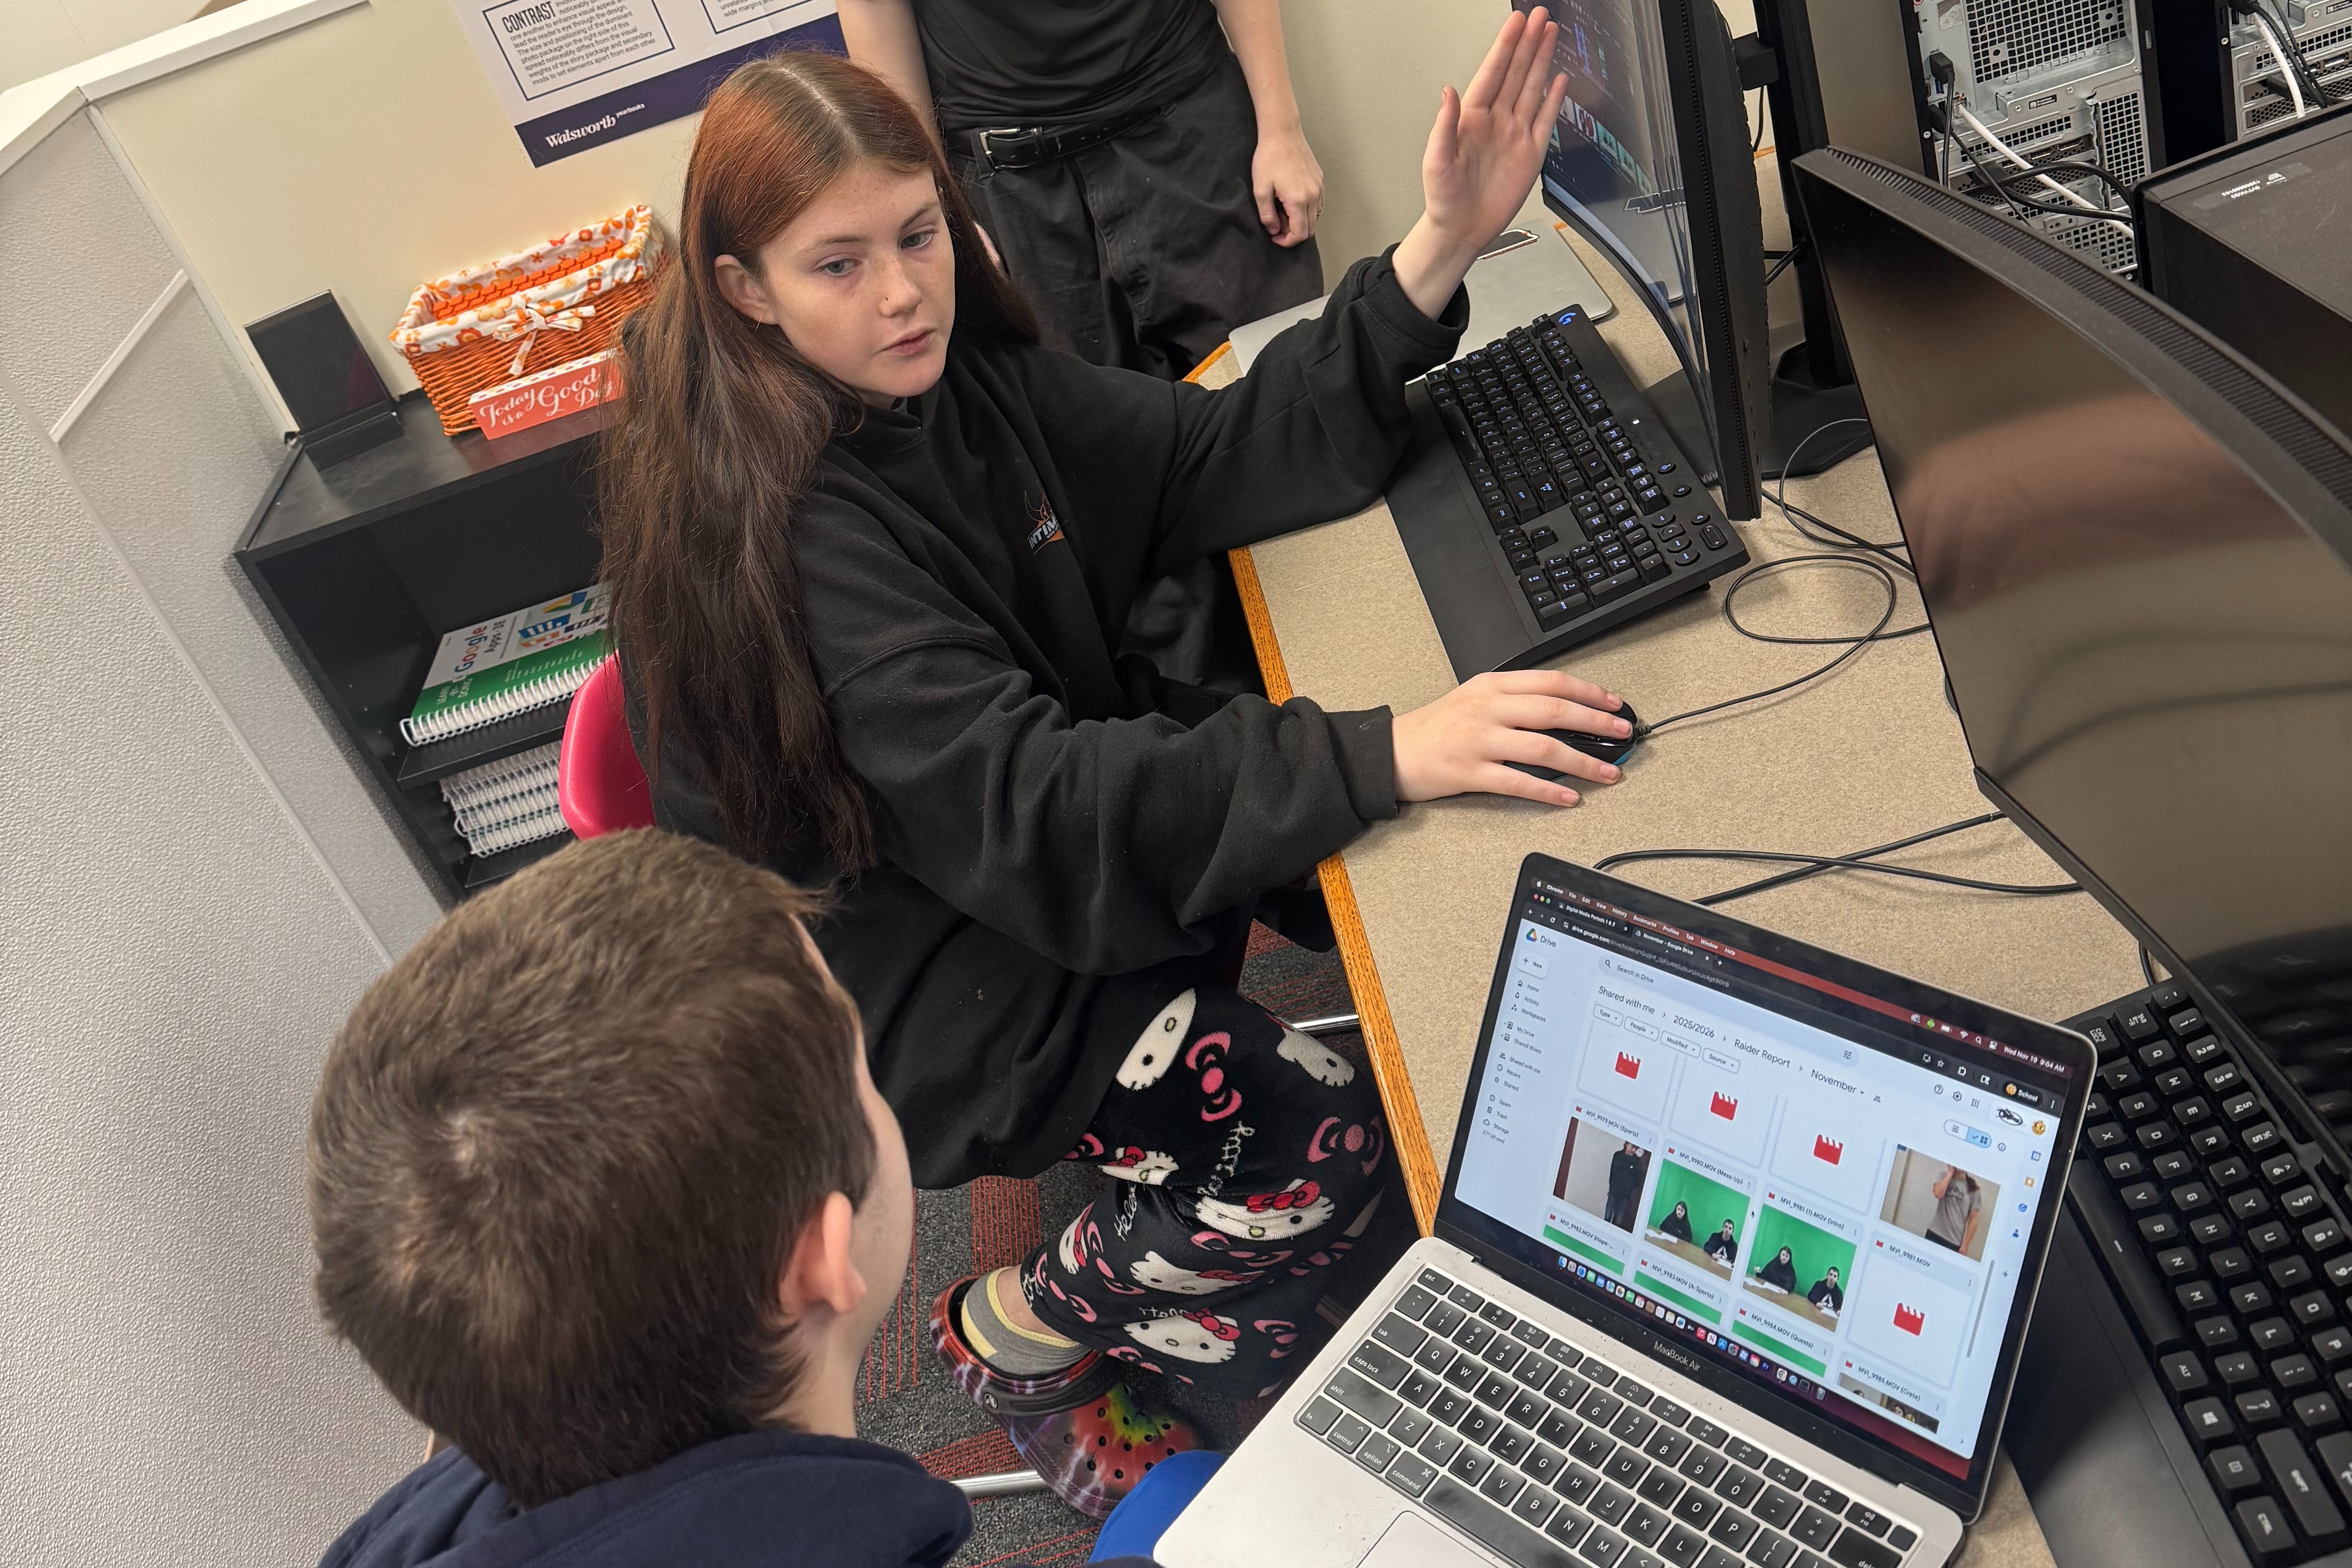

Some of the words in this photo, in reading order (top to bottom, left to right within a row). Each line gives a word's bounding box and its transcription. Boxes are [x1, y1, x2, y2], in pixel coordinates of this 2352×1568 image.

[501, 1, 557, 33] CONTRAST
[523, 25, 545, 36] another
[553, 13, 578, 25] enhance
[579, 7, 596, 16] visual
[596, 0, 616, 11] appeal
[538, 27, 561, 39] reader's
[573, 15, 596, 27] through
[606, 4, 628, 15] design.
[555, 27, 587, 43] positioning
[605, 11, 632, 24] dominant
[522, 53, 539, 63] photo
[539, 44, 564, 57] package
[584, 32, 598, 42] right
[525, 59, 546, 70] spread
[546, 48, 576, 63] noticeably
[576, 41, 595, 52] differs
[596, 36, 610, 45] from
[621, 26, 638, 36] visual
[529, 66, 552, 78] weights
[570, 54, 585, 64] story
[585, 45, 610, 58] package
[623, 30, 653, 45] secondary
[533, 75, 549, 85] mods
[567, 59, 594, 72] elements
[595, 54, 611, 64] apart
[611, 48, 625, 57] from
[625, 43, 640, 52] each
[640, 37, 656, 47] other.
[544, 113, 617, 148] Walsworth
[615, 103, 646, 118] yearbooks
[537, 367, 601, 416] Good
[480, 389, 535, 428] Today
[455, 625, 487, 673] Google
[1547, 884, 1563, 894] Chrome
[1612, 908, 1627, 917] History
[1633, 915, 1657, 927] Bookmarks
[1662, 925, 1679, 936] Profiles
[1700, 939, 1718, 949] Window
[1724, 948, 1735, 956] Help
[1540, 935, 1556, 947] Drive
[1643, 933, 1664, 944] November
[1667, 942, 1682, 951] Google
[1617, 965, 1635, 977] Search
[1640, 973, 1654, 984] Drive
[1527, 984, 1539, 993] Home
[1524, 996, 1539, 1007] Activity
[1598, 985, 1625, 1003] Shared
[1625, 996, 1642, 1010] with
[1642, 1005, 1655, 1015] me
[1521, 1008, 1546, 1023] Workspaces
[1599, 1009, 1611, 1020] Type
[1629, 1021, 1647, 1034] People
[1673, 1015, 1715, 1039] 2025/2026
[1514, 1038, 1528, 1049] Shared
[1528, 1045, 1542, 1054] drives
[1666, 1036, 1688, 1051] Modified
[1708, 1053, 1726, 1066] Source
[1734, 1039, 1761, 1056] Raider
[1761, 1049, 1790, 1069] Report
[2003, 1046, 2017, 1056] Wed
[2017, 1051, 2029, 1060] Nov
[2030, 1055, 2038, 1063] 19
[2039, 1059, 2053, 1069] 9:04
[2054, 1064, 2064, 1073] AM
[1509, 1056, 1524, 1067] Shared
[1524, 1062, 1533, 1071] with
[1507, 1068, 1521, 1078] Recent
[1811, 1069, 1857, 1094] November
[1503, 1080, 1519, 1091] Starred
[1499, 1099, 1511, 1108] Spam
[2017, 1089, 2038, 1102] School
[1496, 1111, 1508, 1120] Trash
[1493, 1123, 1509, 1135] Storage
[1716, 1168, 1743, 1185] (Mess-Up)
[1377, 1328, 1388, 1337] tab
[1654, 1341, 1689, 1365] MacBook
[1689, 1357, 1701, 1371] Air
[1355, 1357, 1368, 1367] caps
[1367, 1363, 1379, 1373] lock
[1330, 1384, 1344, 1396] shift
[1304, 1411, 1312, 1420] fn
[1334, 1431, 1354, 1447] control
[1364, 1451, 1382, 1466] option
[1392, 1469, 1421, 1491] command
